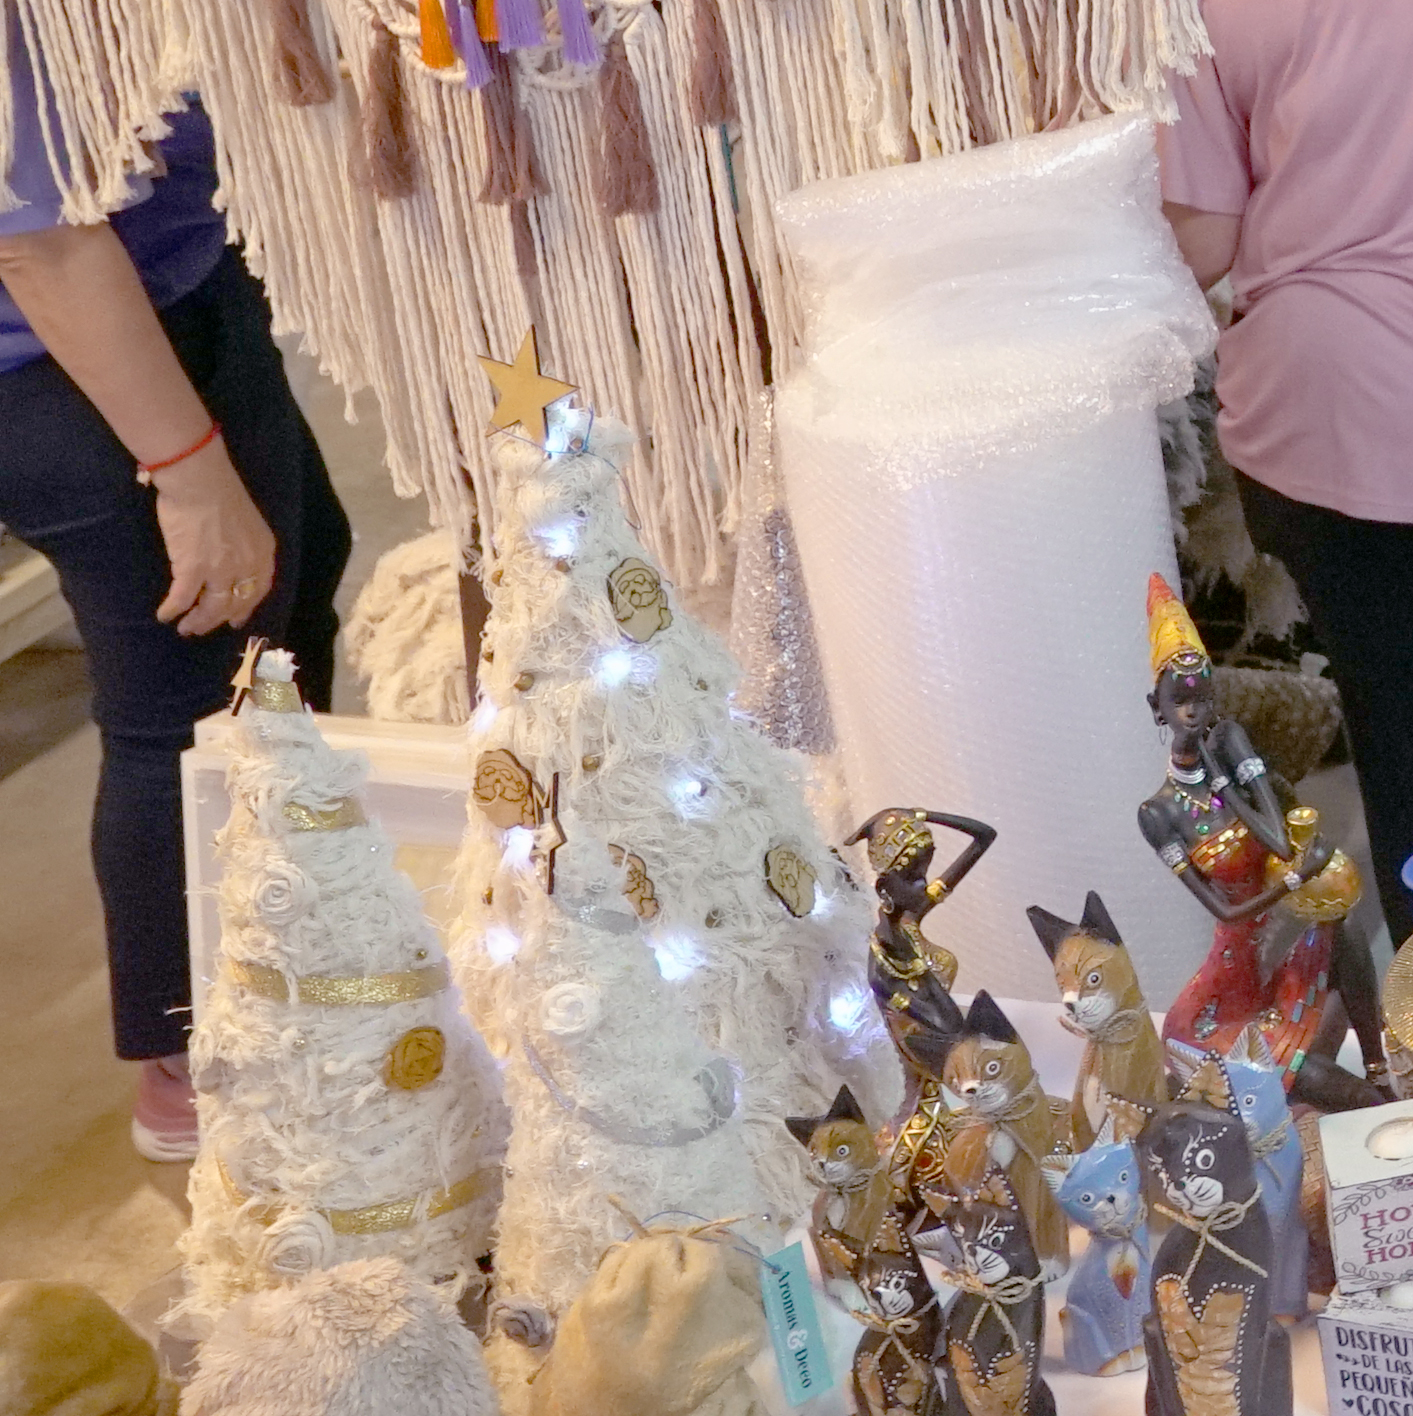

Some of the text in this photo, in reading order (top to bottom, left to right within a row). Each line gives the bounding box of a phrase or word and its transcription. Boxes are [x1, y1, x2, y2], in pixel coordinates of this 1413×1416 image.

[778, 1270, 814, 1389] Aromas & Deco
[1361, 1353, 1413, 1376] DE LAS
